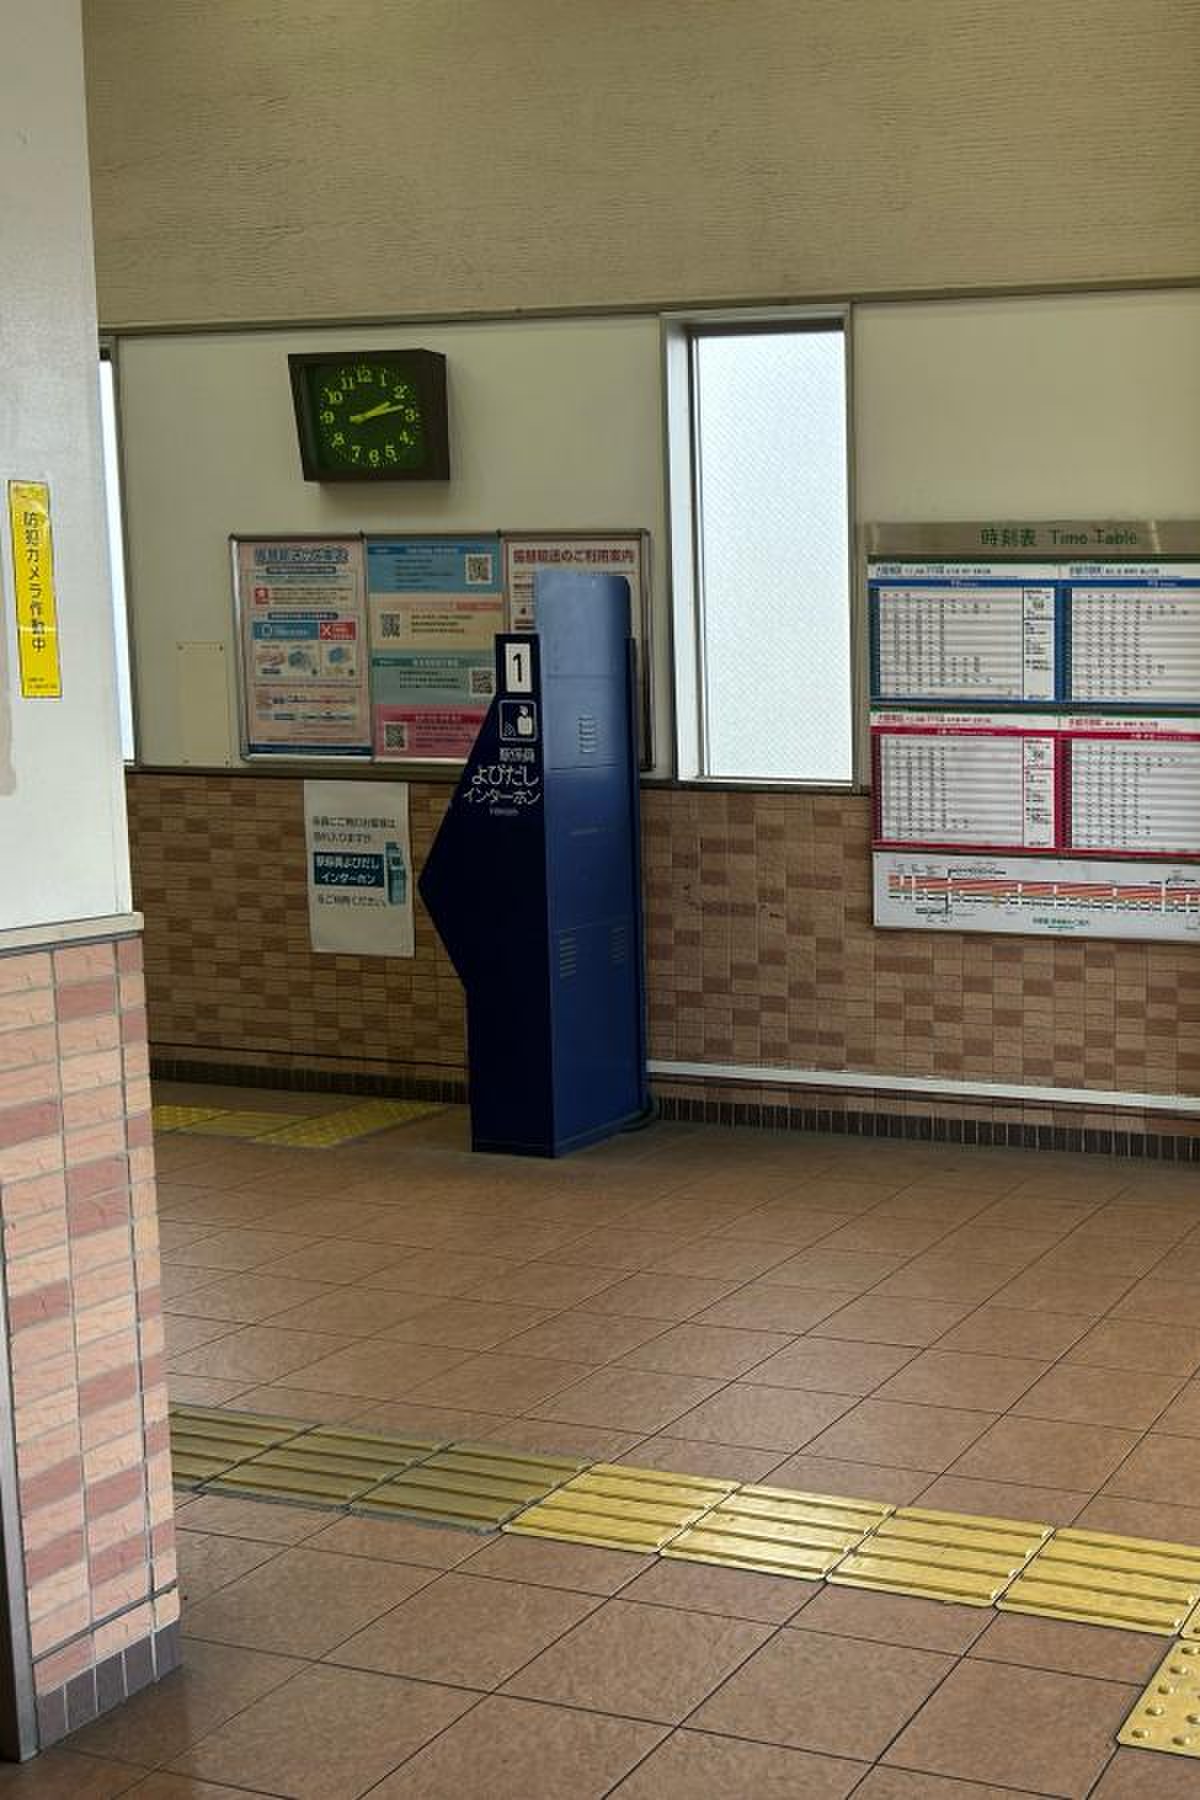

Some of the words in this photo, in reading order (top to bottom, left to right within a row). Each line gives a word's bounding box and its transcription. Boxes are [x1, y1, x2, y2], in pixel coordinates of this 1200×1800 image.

[340, 376, 354, 391] 11
[356, 368, 373, 384] 12
[380, 371, 387, 388] 1
[327, 390, 343, 405] 10
[393, 386, 406, 400] 2
[322, 410, 335, 425] 9
[404, 408, 416, 423] 3
[333, 431, 346, 446] 8
[399, 431, 410, 444] 4
[351, 445, 362, 459] 7
[368, 449, 380, 464] 6
[384, 445, 396, 459] 5
[980, 527, 1037, 547] 時刻表
[1049, 527, 1089, 545] Time
[1093, 527, 1138, 545] Table
[22, 510, 47, 653] 防犯カメラ作動中
[512, 652, 523, 683] 1
[471, 766, 540, 787] よびだし
[463, 789, 542, 805] インターホン
[321, 871, 376, 885] インターホン
